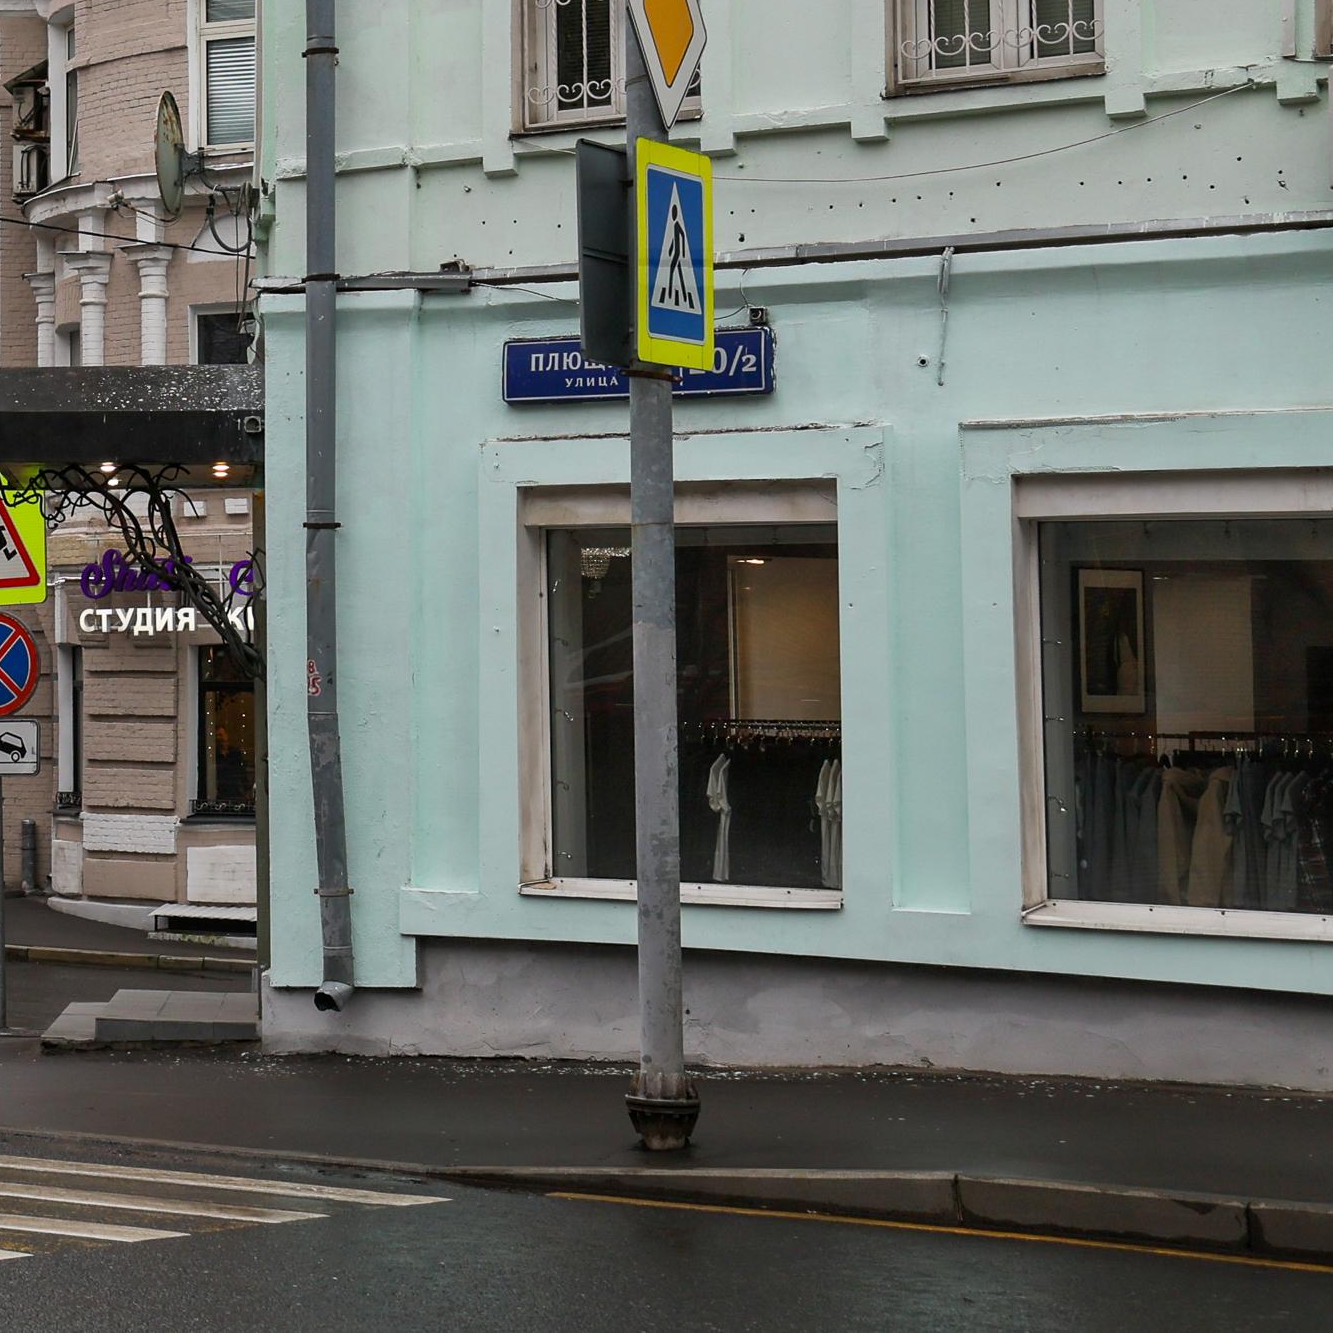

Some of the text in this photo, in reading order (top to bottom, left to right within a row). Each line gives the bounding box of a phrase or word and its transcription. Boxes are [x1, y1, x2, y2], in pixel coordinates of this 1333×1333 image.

[689, 345, 757, 376] 0/2
[565, 376, 619, 388] УЛИЦА
[79, 607, 196, 636] СТУДИЯ
